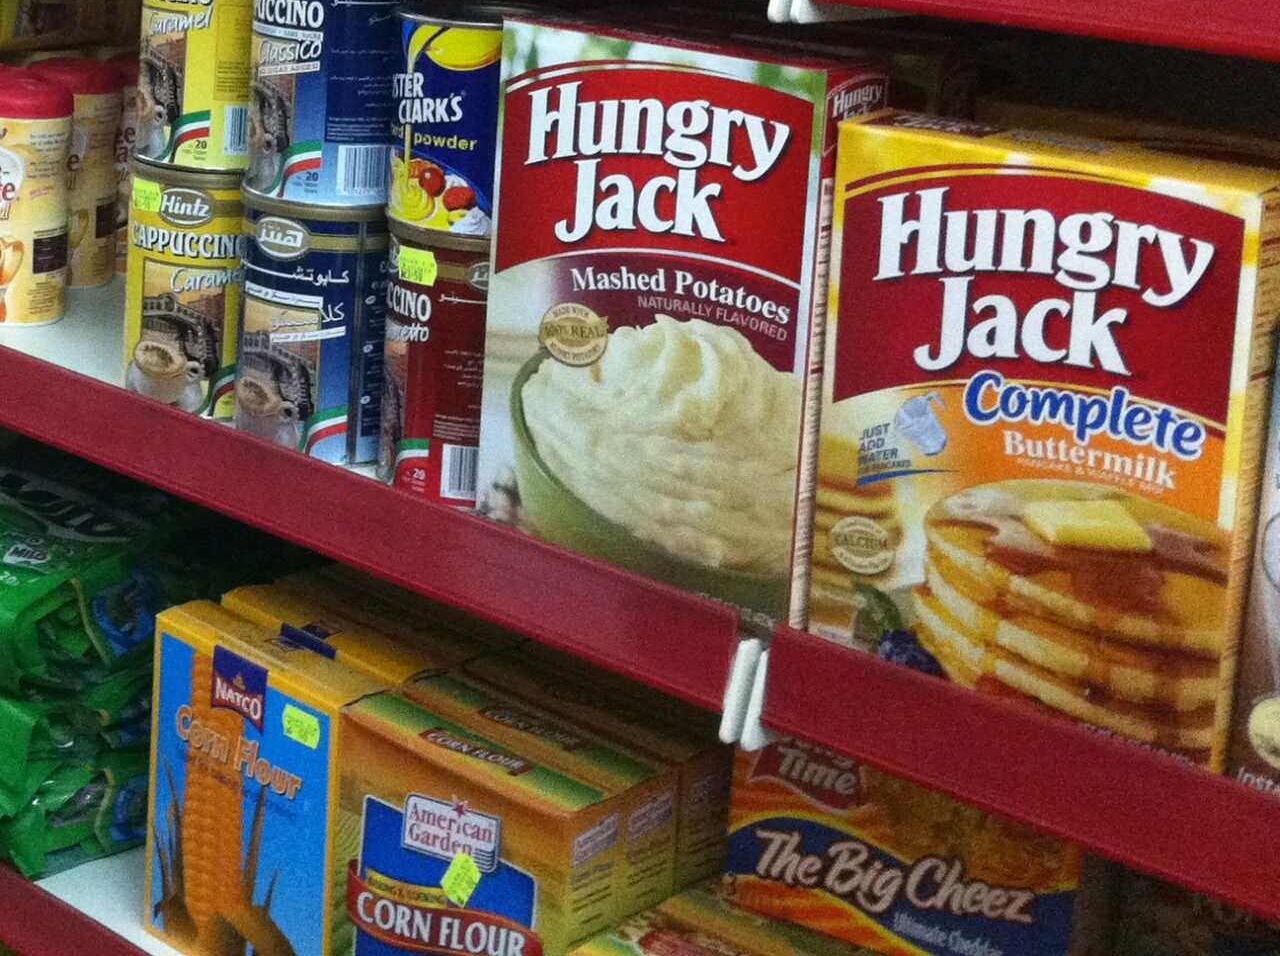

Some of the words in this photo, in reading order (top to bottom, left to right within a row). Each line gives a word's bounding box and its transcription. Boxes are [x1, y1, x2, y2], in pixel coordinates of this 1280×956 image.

[146, 6, 214, 37] Caramel
[398, 92, 464, 125] CLARK'S
[832, 83, 884, 119] Hungry
[413, 131, 478, 151] powder
[523, 80, 791, 182] Hungry
[305, 170, 319, 183] 20
[553, 157, 726, 243] Jack
[160, 193, 210, 217] Hintz
[872, 185, 1216, 308] Hungry
[170, 266, 241, 293] Carame
[569, 265, 667, 293] Mashed
[673, 269, 791, 325] Potatoes
[637, 294, 713, 319] NATURALLY
[715, 305, 788, 343] FLAVORED
[912, 275, 1132, 377] Jack
[859, 423, 891, 441] JUST
[964, 370, 1207, 462] Complete
[1001, 428, 1178, 491] Buttermilk
[215, 677, 263, 722] NATCO
[175, 704, 229, 765] Corn
[233, 735, 304, 801] Flour
[424, 730, 476, 758] CORN
[776, 744, 858, 795] Time
[407, 823, 474, 856] Garden
[408, 800, 493, 846] American
[755, 828, 823, 887] The
[827, 842, 903, 915] Big
[906, 856, 1035, 924] Cheez
[356, 890, 433, 944] CORN
[438, 915, 526, 956] FLOUR
